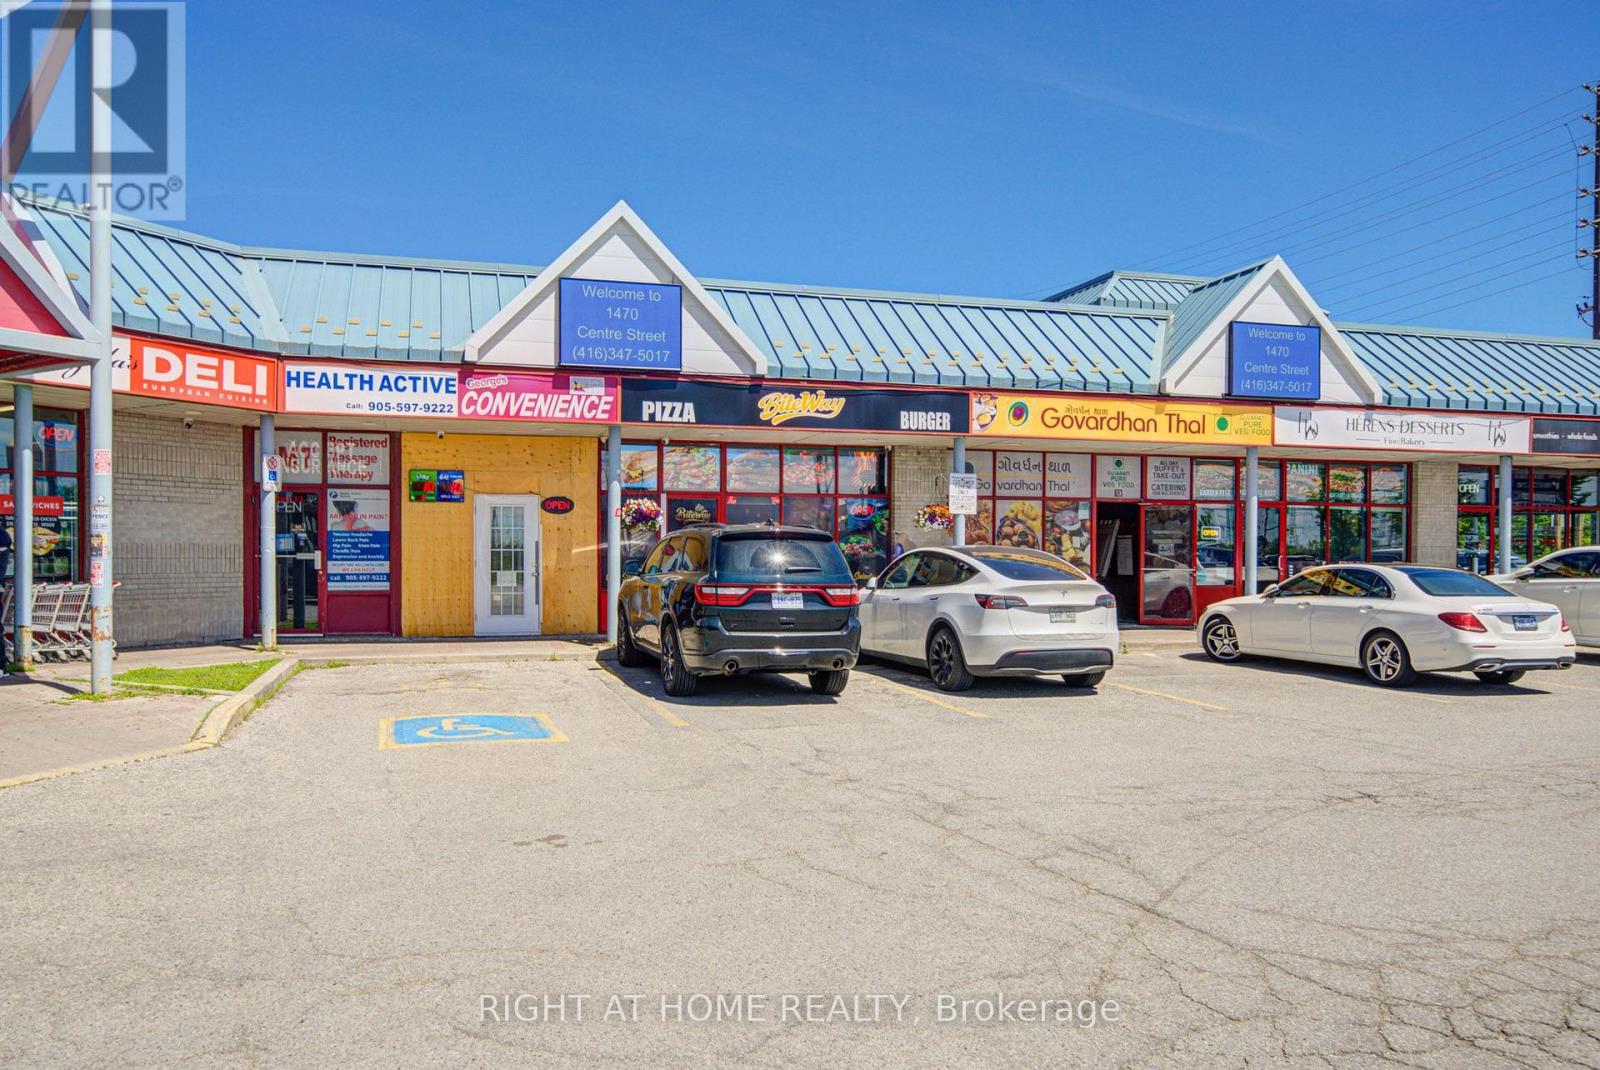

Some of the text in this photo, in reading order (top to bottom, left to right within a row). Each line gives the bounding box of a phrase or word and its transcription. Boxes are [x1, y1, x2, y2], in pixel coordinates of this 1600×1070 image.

[582, 285, 662, 302] Welcome to
[606, 306, 639, 321] 1470
[577, 325, 666, 343] Centre Street
[1248, 327, 1306, 342] Welcome to
[572, 345, 670, 363] (416)347-5017
[1265, 345, 1290, 358] 1470
[142, 345, 268, 396] DELI
[1244, 361, 1310, 376] Centre Street
[286, 370, 458, 395] HEALTH ACTIVE
[1241, 379, 1312, 393] (416)347-5017
[142, 383, 269, 405] EUROPEAN CUISINE
[368, 401, 454, 414] 905-597-9222
[460, 390, 615, 420] CONVENIENCE
[642, 400, 696, 423] PIZZA
[900, 410, 951, 432] BURGER
[1041, 407, 1206, 435] Govardhan Thal
[1400, 420, 1465, 436] DESSERTS
[38, 426, 75, 442] OPEN
[328, 436, 388, 451] Registered
[328, 452, 378, 466] Massage
[328, 467, 374, 482] Therapy
[1153, 465, 1180, 473] BUFFET
[1286, 463, 1319, 475] PANINI
[1048, 480, 1070, 492] Thal
[1151, 483, 1187, 492] CATERING
[1458, 483, 1480, 494] OPEN
[544, 500, 570, 510] OPEN
